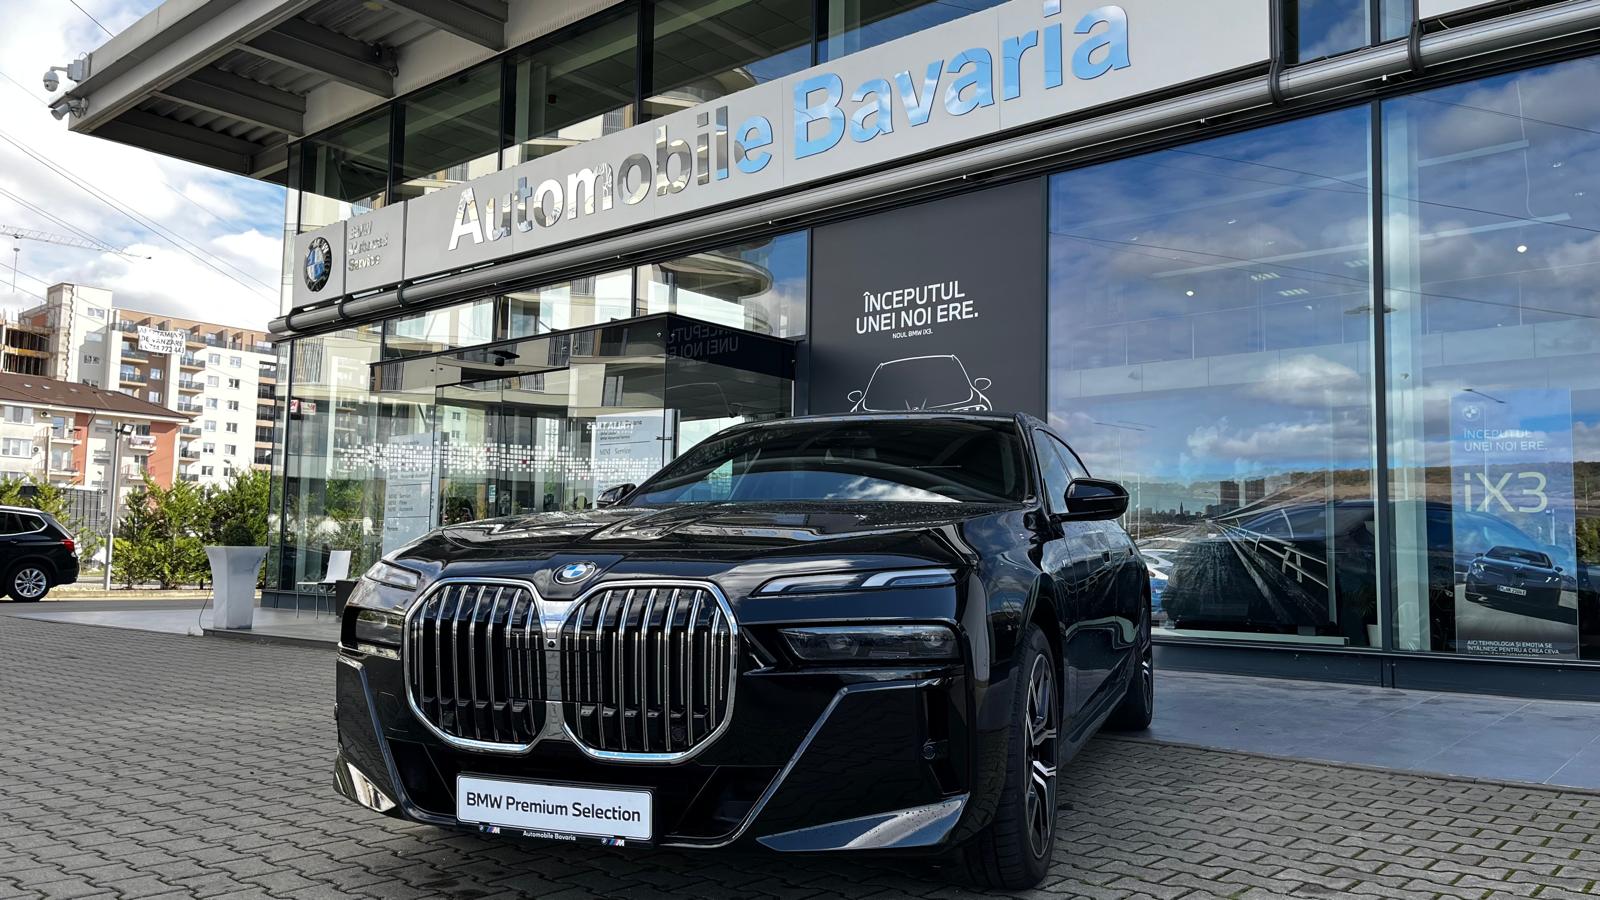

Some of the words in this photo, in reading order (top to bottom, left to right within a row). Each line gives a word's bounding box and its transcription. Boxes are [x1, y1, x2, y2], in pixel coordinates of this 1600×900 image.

[447, 105, 774, 251] Automobile
[793, 0, 1131, 160] Bavaria
[348, 254, 381, 271] Service
[863, 280, 965, 313] ÎNCEPUTUL
[856, 312, 896, 334] UNEI
[901, 306, 932, 328] NOI
[937, 300, 979, 323] ERE.
[908, 329, 922, 337] BMW
[1464, 441, 1492, 452] UNEI
[1495, 441, 1517, 451] NOI
[1521, 440, 1548, 450] ERE.
[1463, 471, 1548, 513] iX3
[466, 791, 503, 810] BMW
[506, 796, 568, 816] Premium
[572, 802, 641, 822] Selection
[522, 830, 554, 839] Automobile
[554, 832, 577, 841] Bavaria
